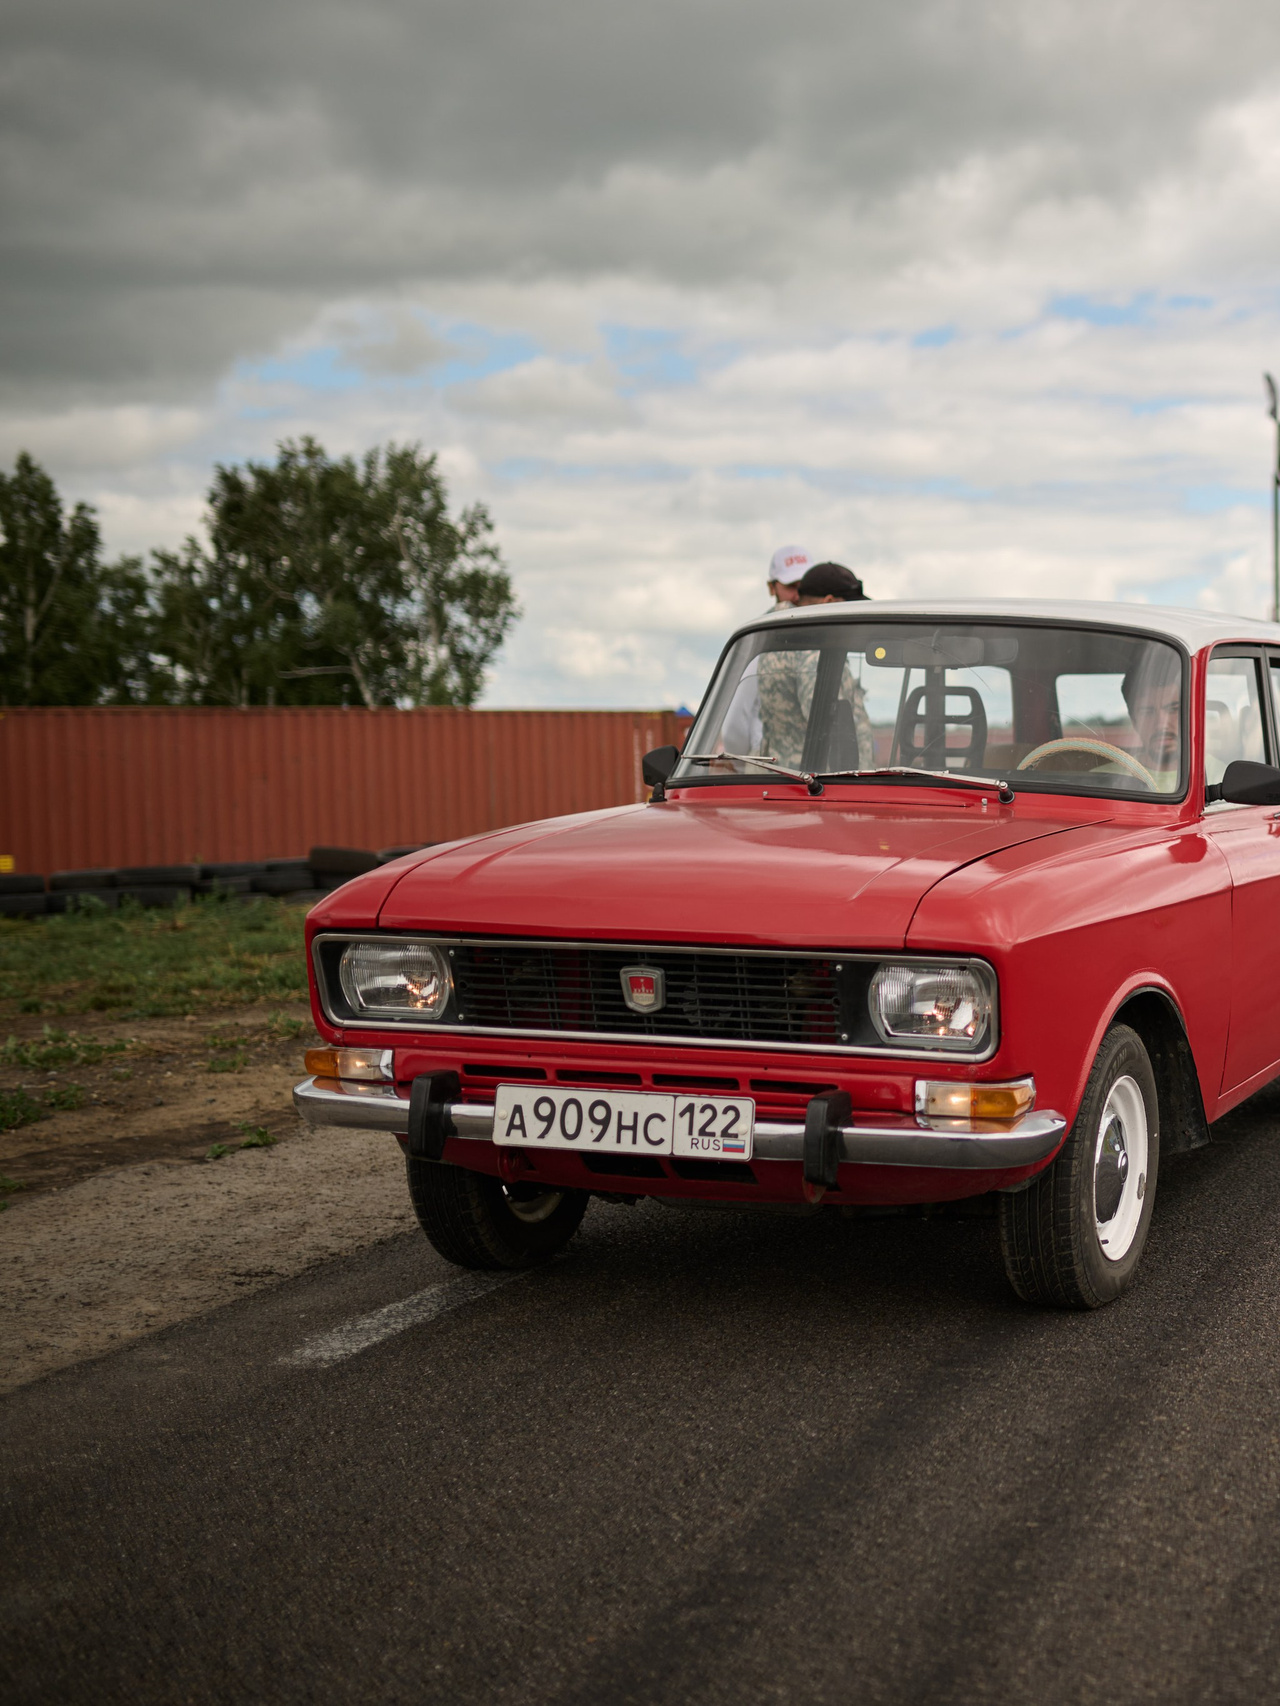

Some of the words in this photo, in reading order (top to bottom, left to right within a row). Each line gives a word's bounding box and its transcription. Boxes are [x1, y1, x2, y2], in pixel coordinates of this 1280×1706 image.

[505, 1095, 667, 1147] А909НС
[678, 1102, 741, 1139] 122
[690, 1138, 721, 1151] RUS
